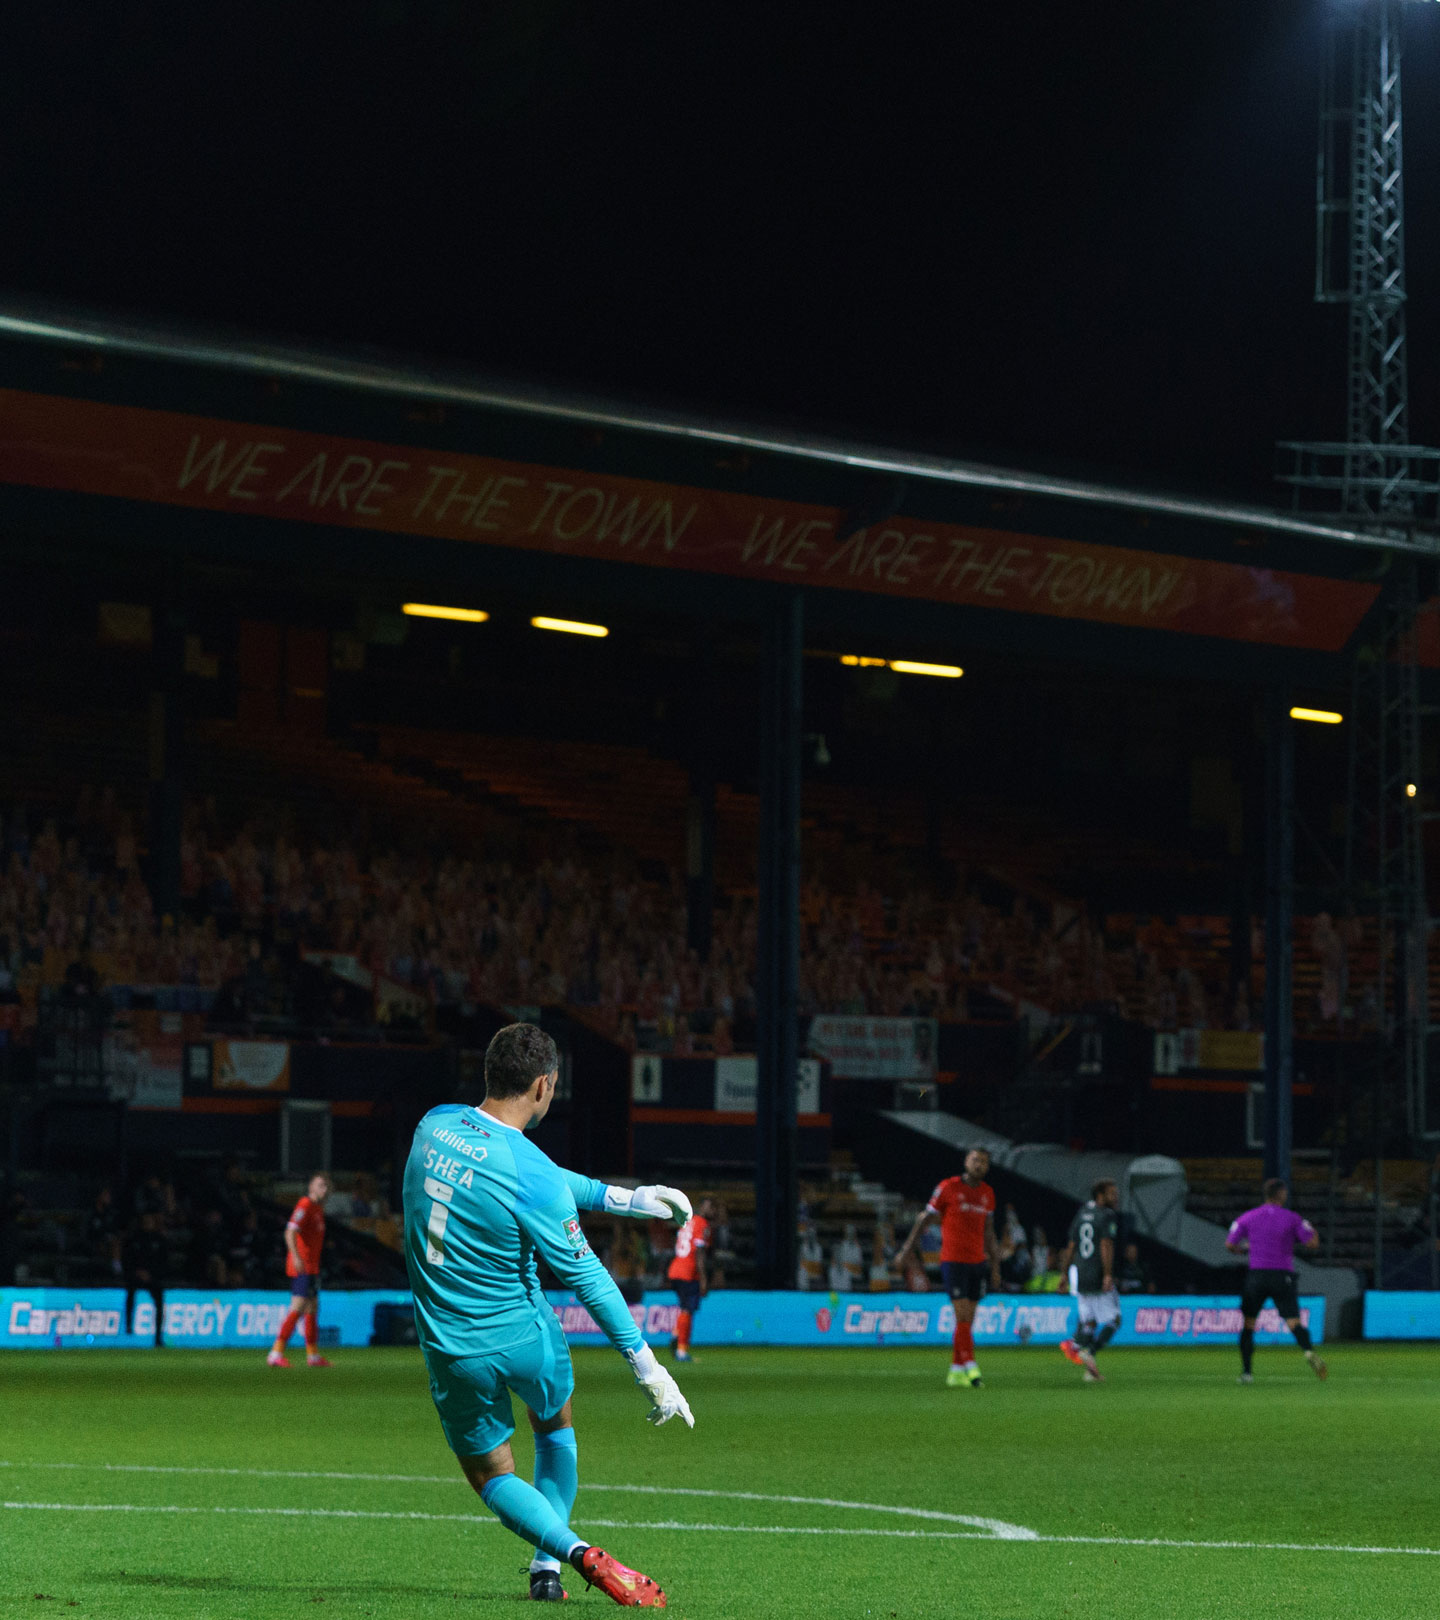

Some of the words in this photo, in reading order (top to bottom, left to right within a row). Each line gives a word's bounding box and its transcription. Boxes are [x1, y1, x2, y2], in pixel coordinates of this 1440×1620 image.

[178, 435, 285, 498] WE
[275, 453, 410, 515] ARE
[412, 466, 528, 531] THE
[528, 482, 697, 549] TOWN
[741, 513, 832, 571] WE
[821, 528, 935, 584] ARE
[934, 539, 1032, 596] THE
[432, 1127, 473, 1156] utilita
[424, 1149, 474, 1189] SHEA
[424, 1176, 454, 1265] 1
[1079, 1222, 1095, 1259] 8
[9, 1302, 120, 1334] Carabao
[134, 1304, 231, 1335] EERGY
[844, 1304, 929, 1333] Carabao
[938, 1306, 1012, 1334] ERGY
